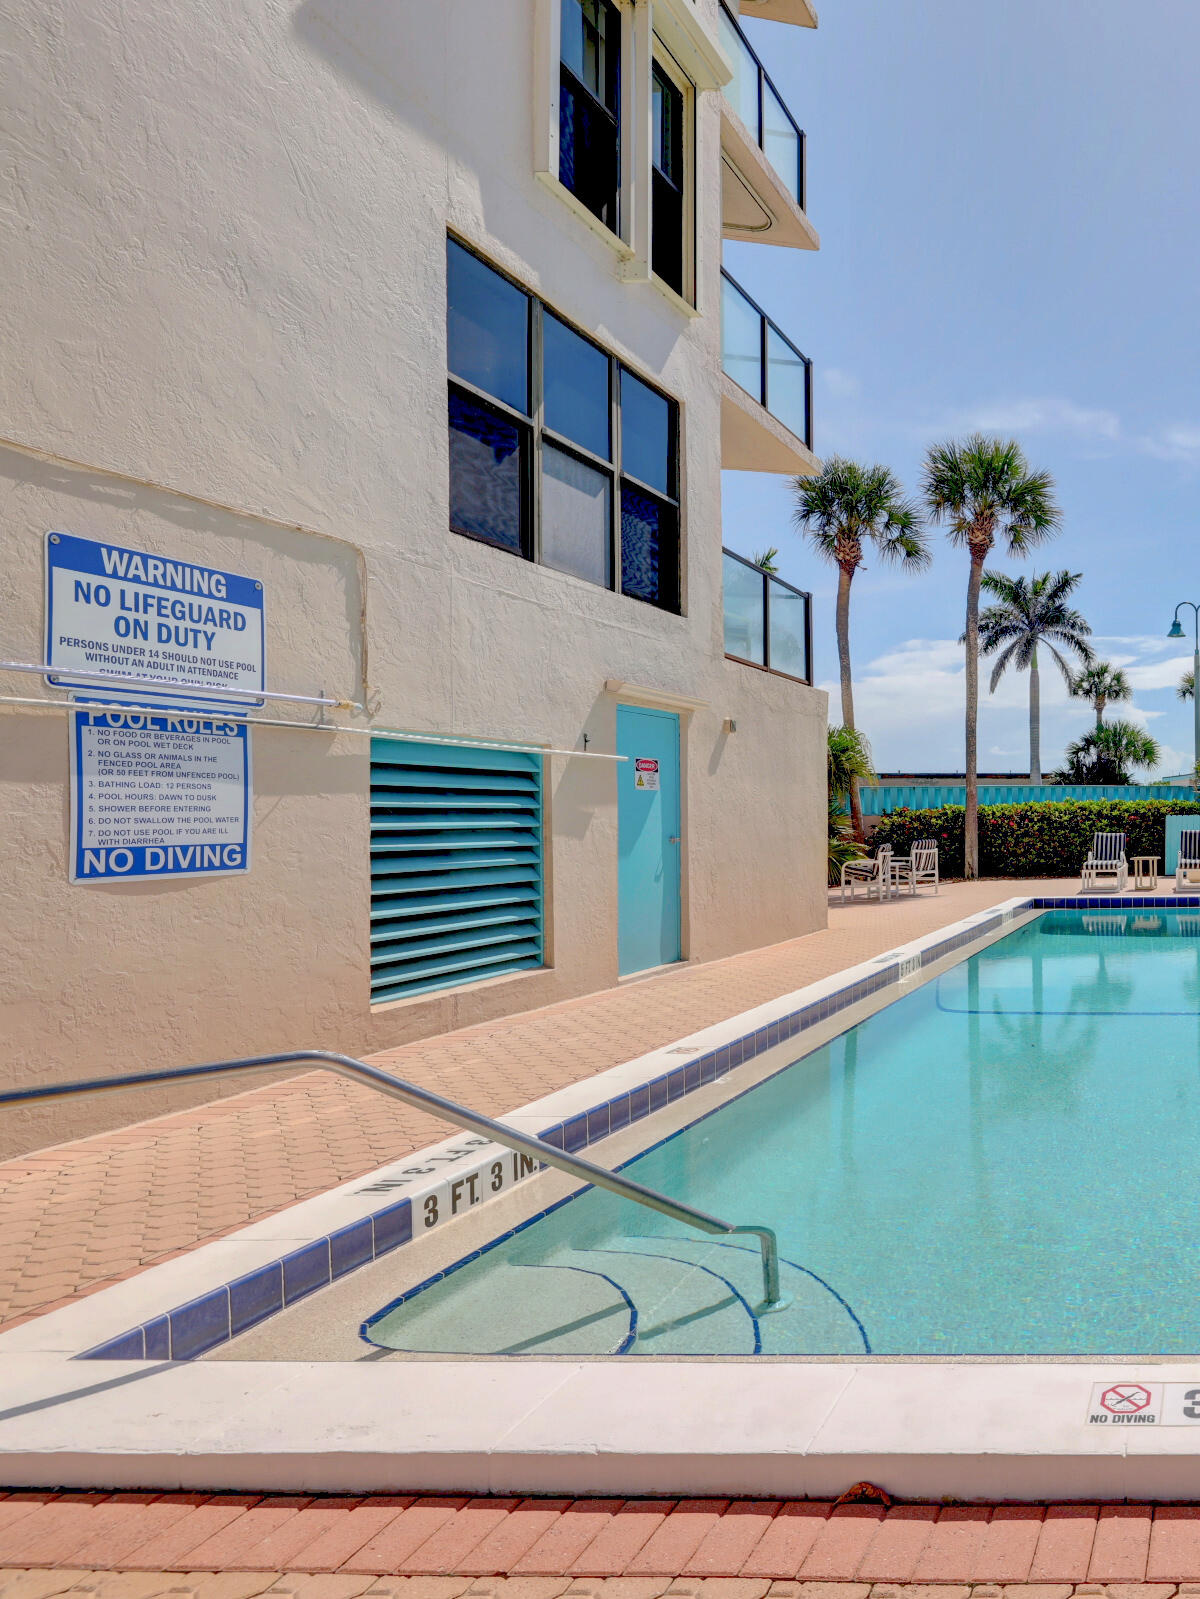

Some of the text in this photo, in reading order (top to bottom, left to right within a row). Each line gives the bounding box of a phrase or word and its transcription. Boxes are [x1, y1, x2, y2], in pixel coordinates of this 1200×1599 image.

[101, 548, 227, 599] WARNING
[74, 580, 246, 632] NO LIFEGUARD
[114, 616, 216, 651] ON DUTY
[60, 636, 256, 672] PERSONS UNDER 14 SHOULD NOT USE POOL
[85, 652, 239, 680] WITHOUT AN ADULT IN ATTENDANCE
[88, 702, 160, 730] POOL
[113, 730, 138, 738] FOOD
[154, 734, 200, 742] BEVERAGES
[128, 740, 151, 748] POOL
[98, 760, 133, 768] FENCED
[158, 754, 192, 762] ANIMALS
[98, 780, 136, 788] BATHING
[84, 844, 242, 874] NO DIVING
[424, 1152, 537, 1228] 3 FT. 3 IN.
[1090, 1414, 1156, 1424] NO DIVING
